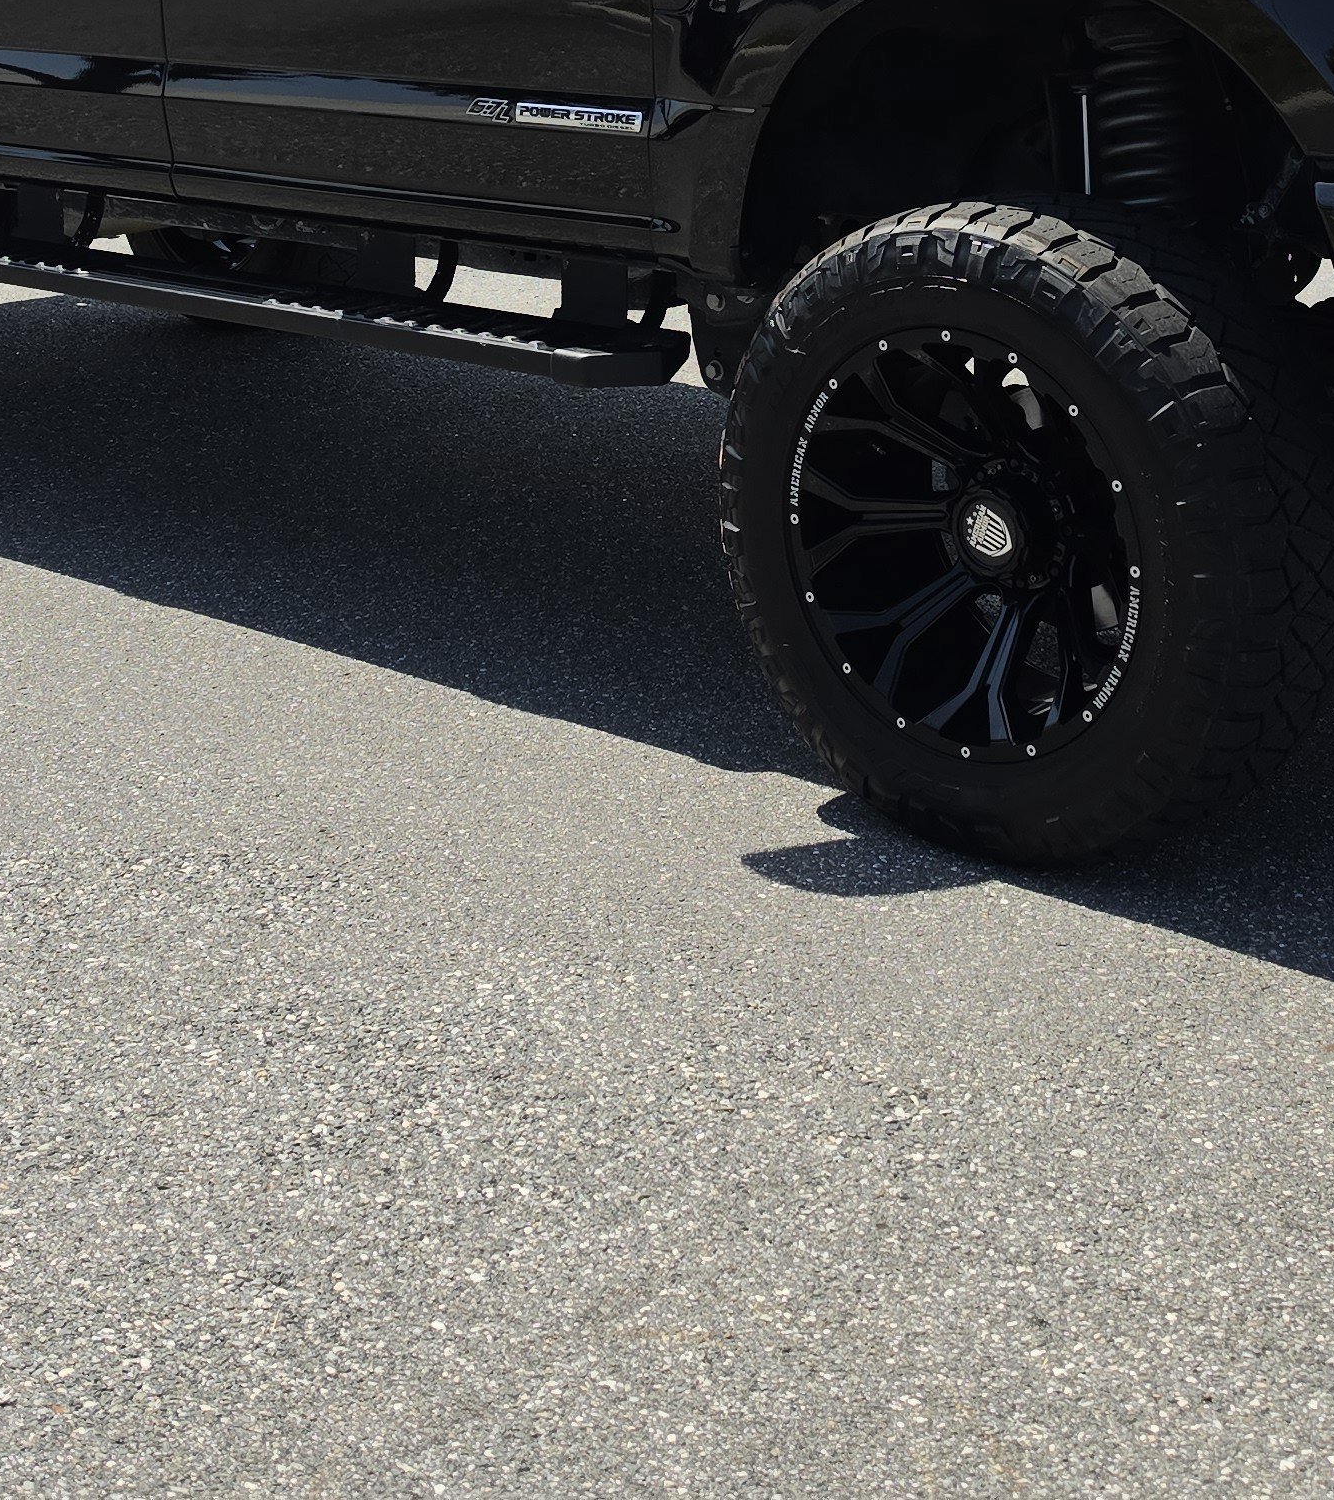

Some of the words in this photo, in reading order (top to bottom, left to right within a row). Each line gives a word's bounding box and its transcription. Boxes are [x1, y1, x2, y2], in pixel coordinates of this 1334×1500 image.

[466, 97, 513, 124] 6.7L
[519, 105, 571, 120] POWER
[574, 110, 636, 126] STROKE
[789, 436, 809, 507] AMERICAN
[803, 391, 829, 434] ARMOR
[1117, 585, 1141, 663] AMERICAN
[1092, 665, 1123, 710] ARMOR
